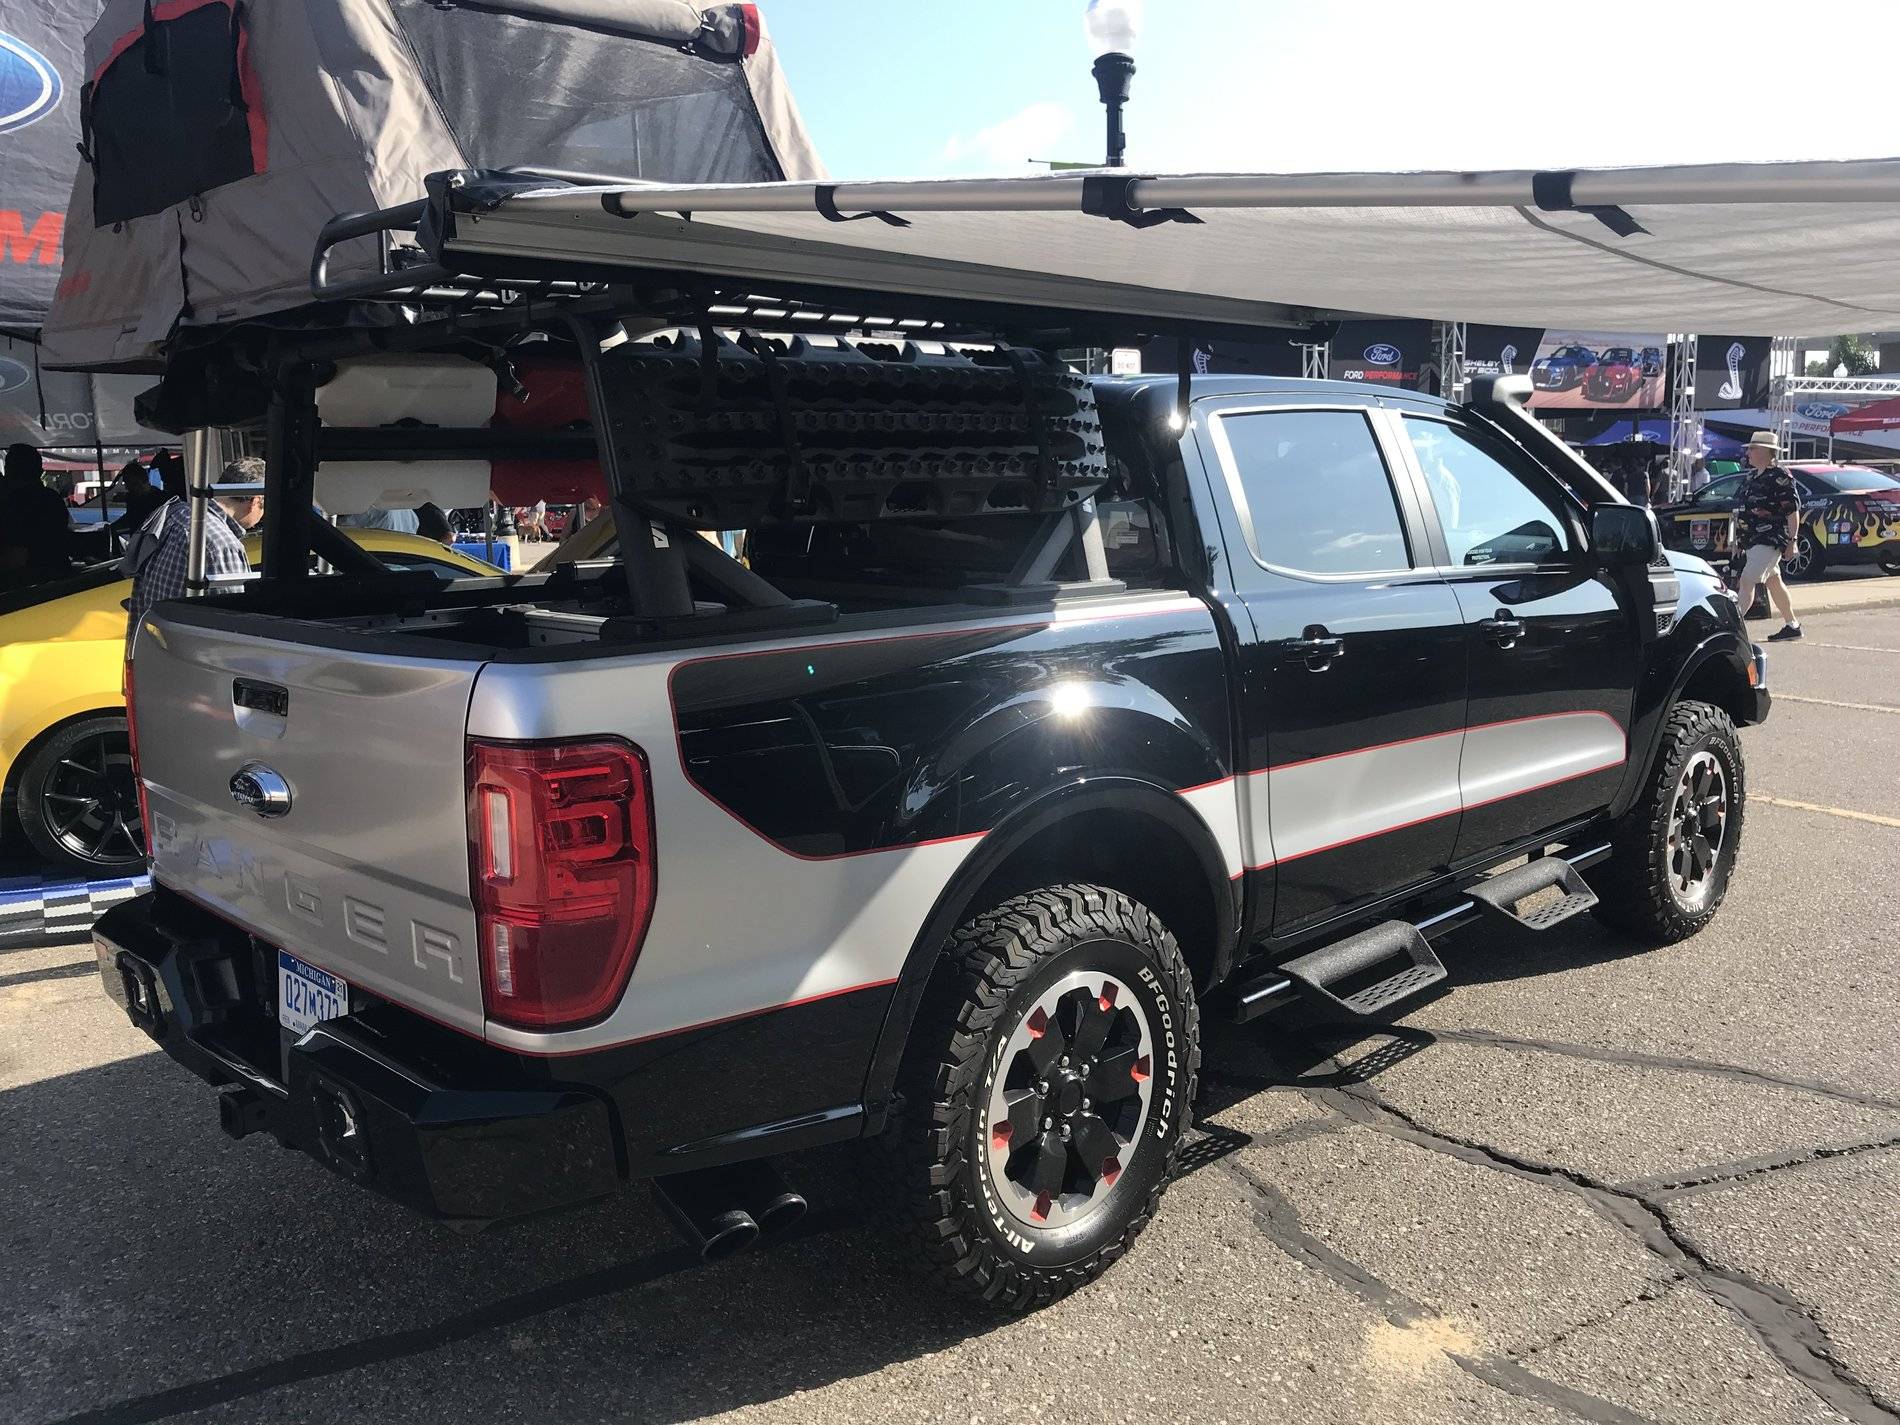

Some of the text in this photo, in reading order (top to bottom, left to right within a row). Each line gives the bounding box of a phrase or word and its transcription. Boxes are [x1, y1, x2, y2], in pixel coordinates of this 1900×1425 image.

[1370, 346, 1394, 361] Ford
[1463, 359, 1501, 368] SHELBY
[1343, 370, 1419, 380] FORD PERFORMANCE
[1804, 401, 1840, 419] Ford
[152, 811, 464, 984] RANGER
[295, 959, 332, 990] MICHIGAN
[1137, 965, 1178, 1140] BFGoodrich
